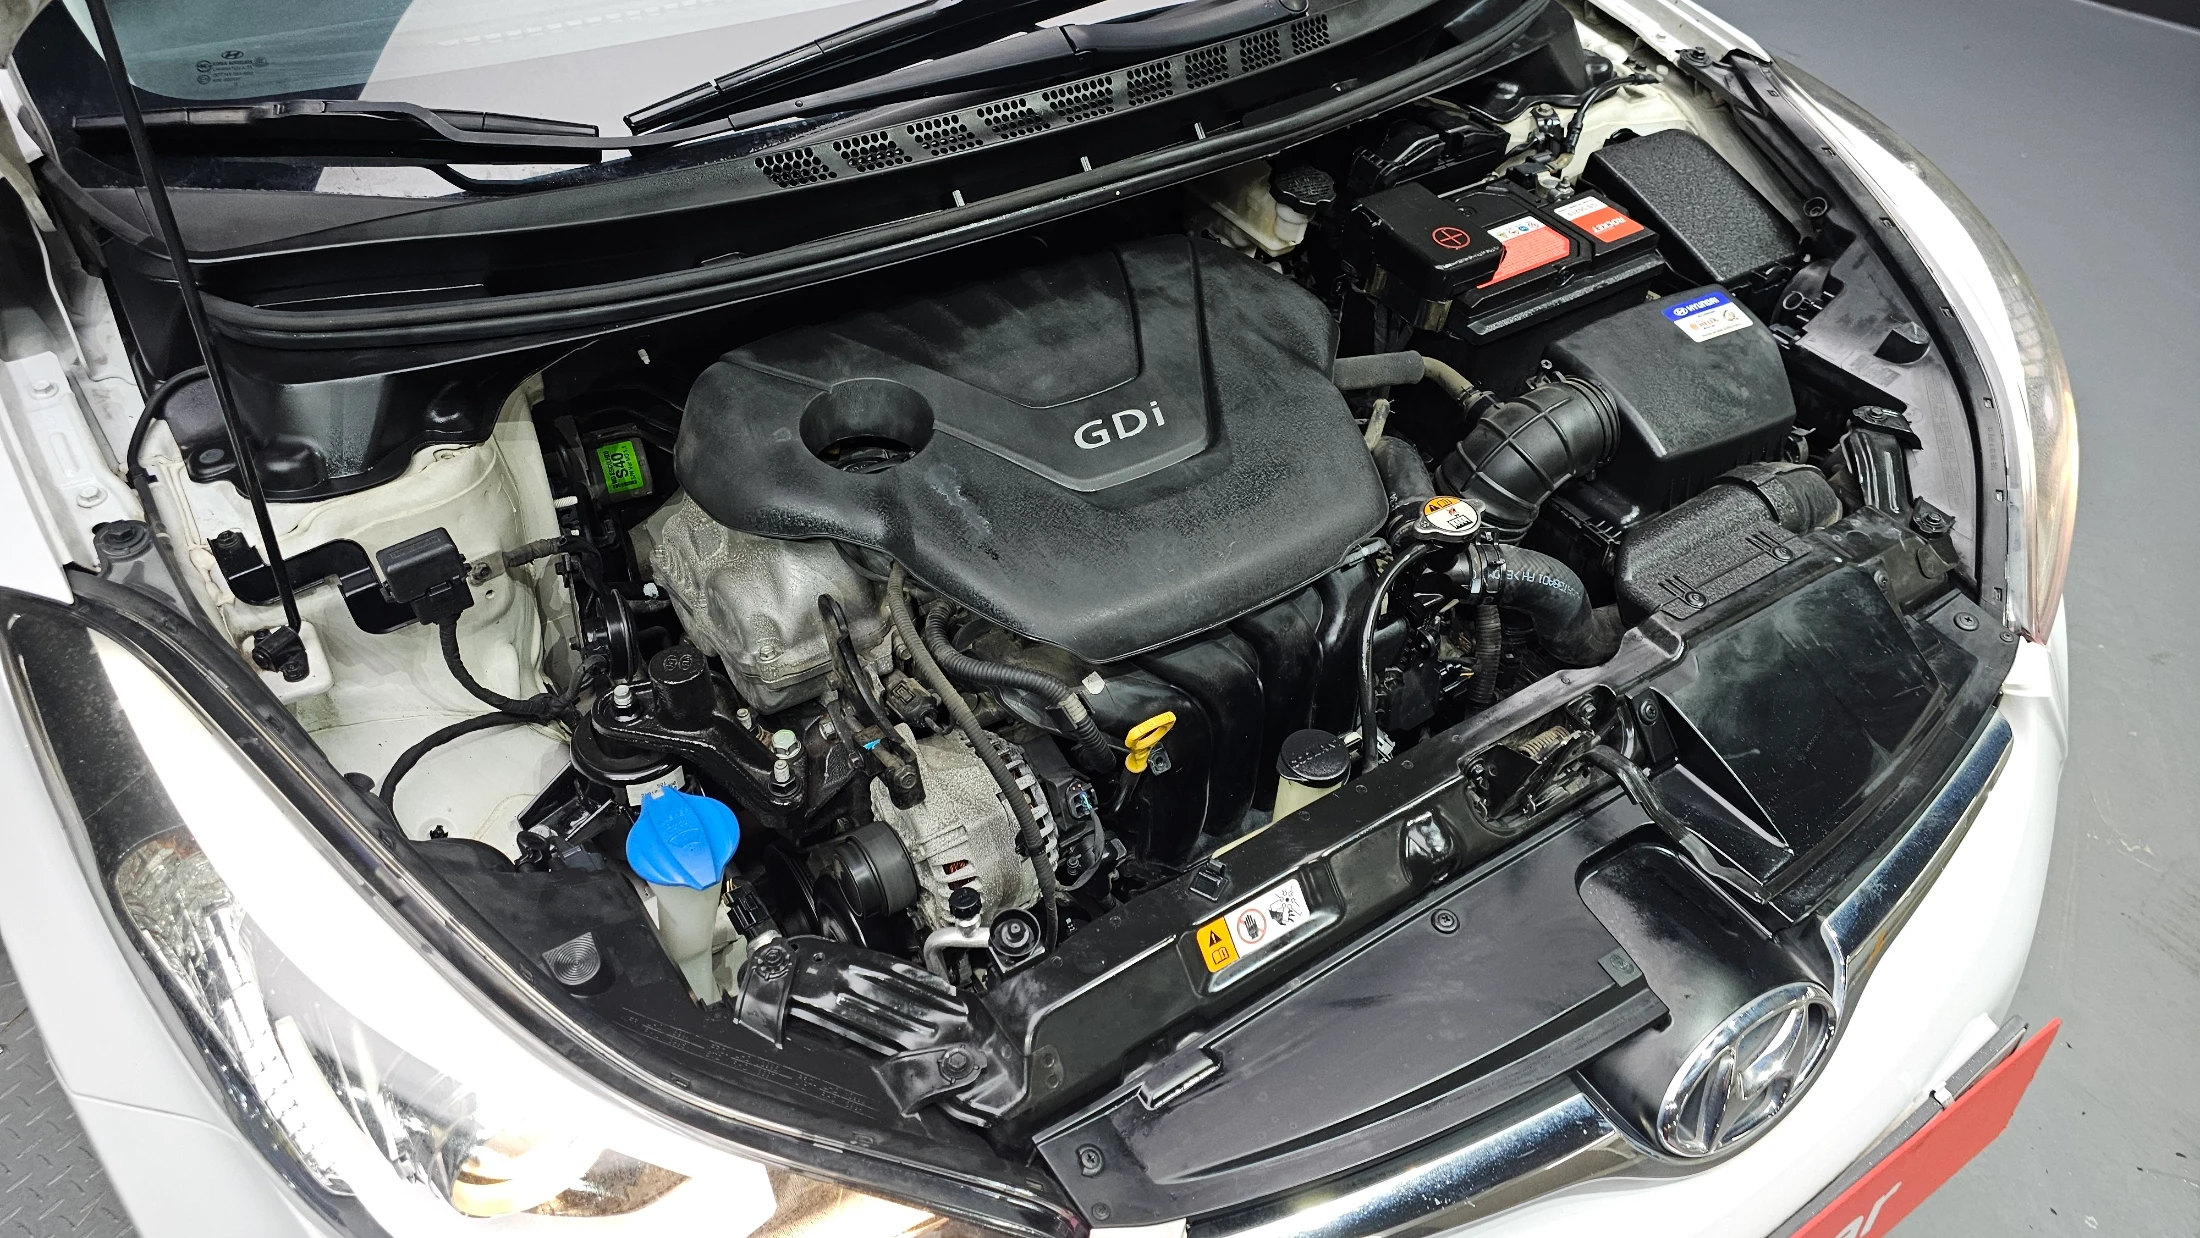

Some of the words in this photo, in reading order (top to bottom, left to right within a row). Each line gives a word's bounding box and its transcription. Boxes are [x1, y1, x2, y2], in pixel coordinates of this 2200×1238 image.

[1592, 216, 1626, 233] ROCKET
[1686, 297, 1720, 312] HYUNDAI
[1074, 400, 1165, 450] GDi
[609, 451, 629, 479] S40
